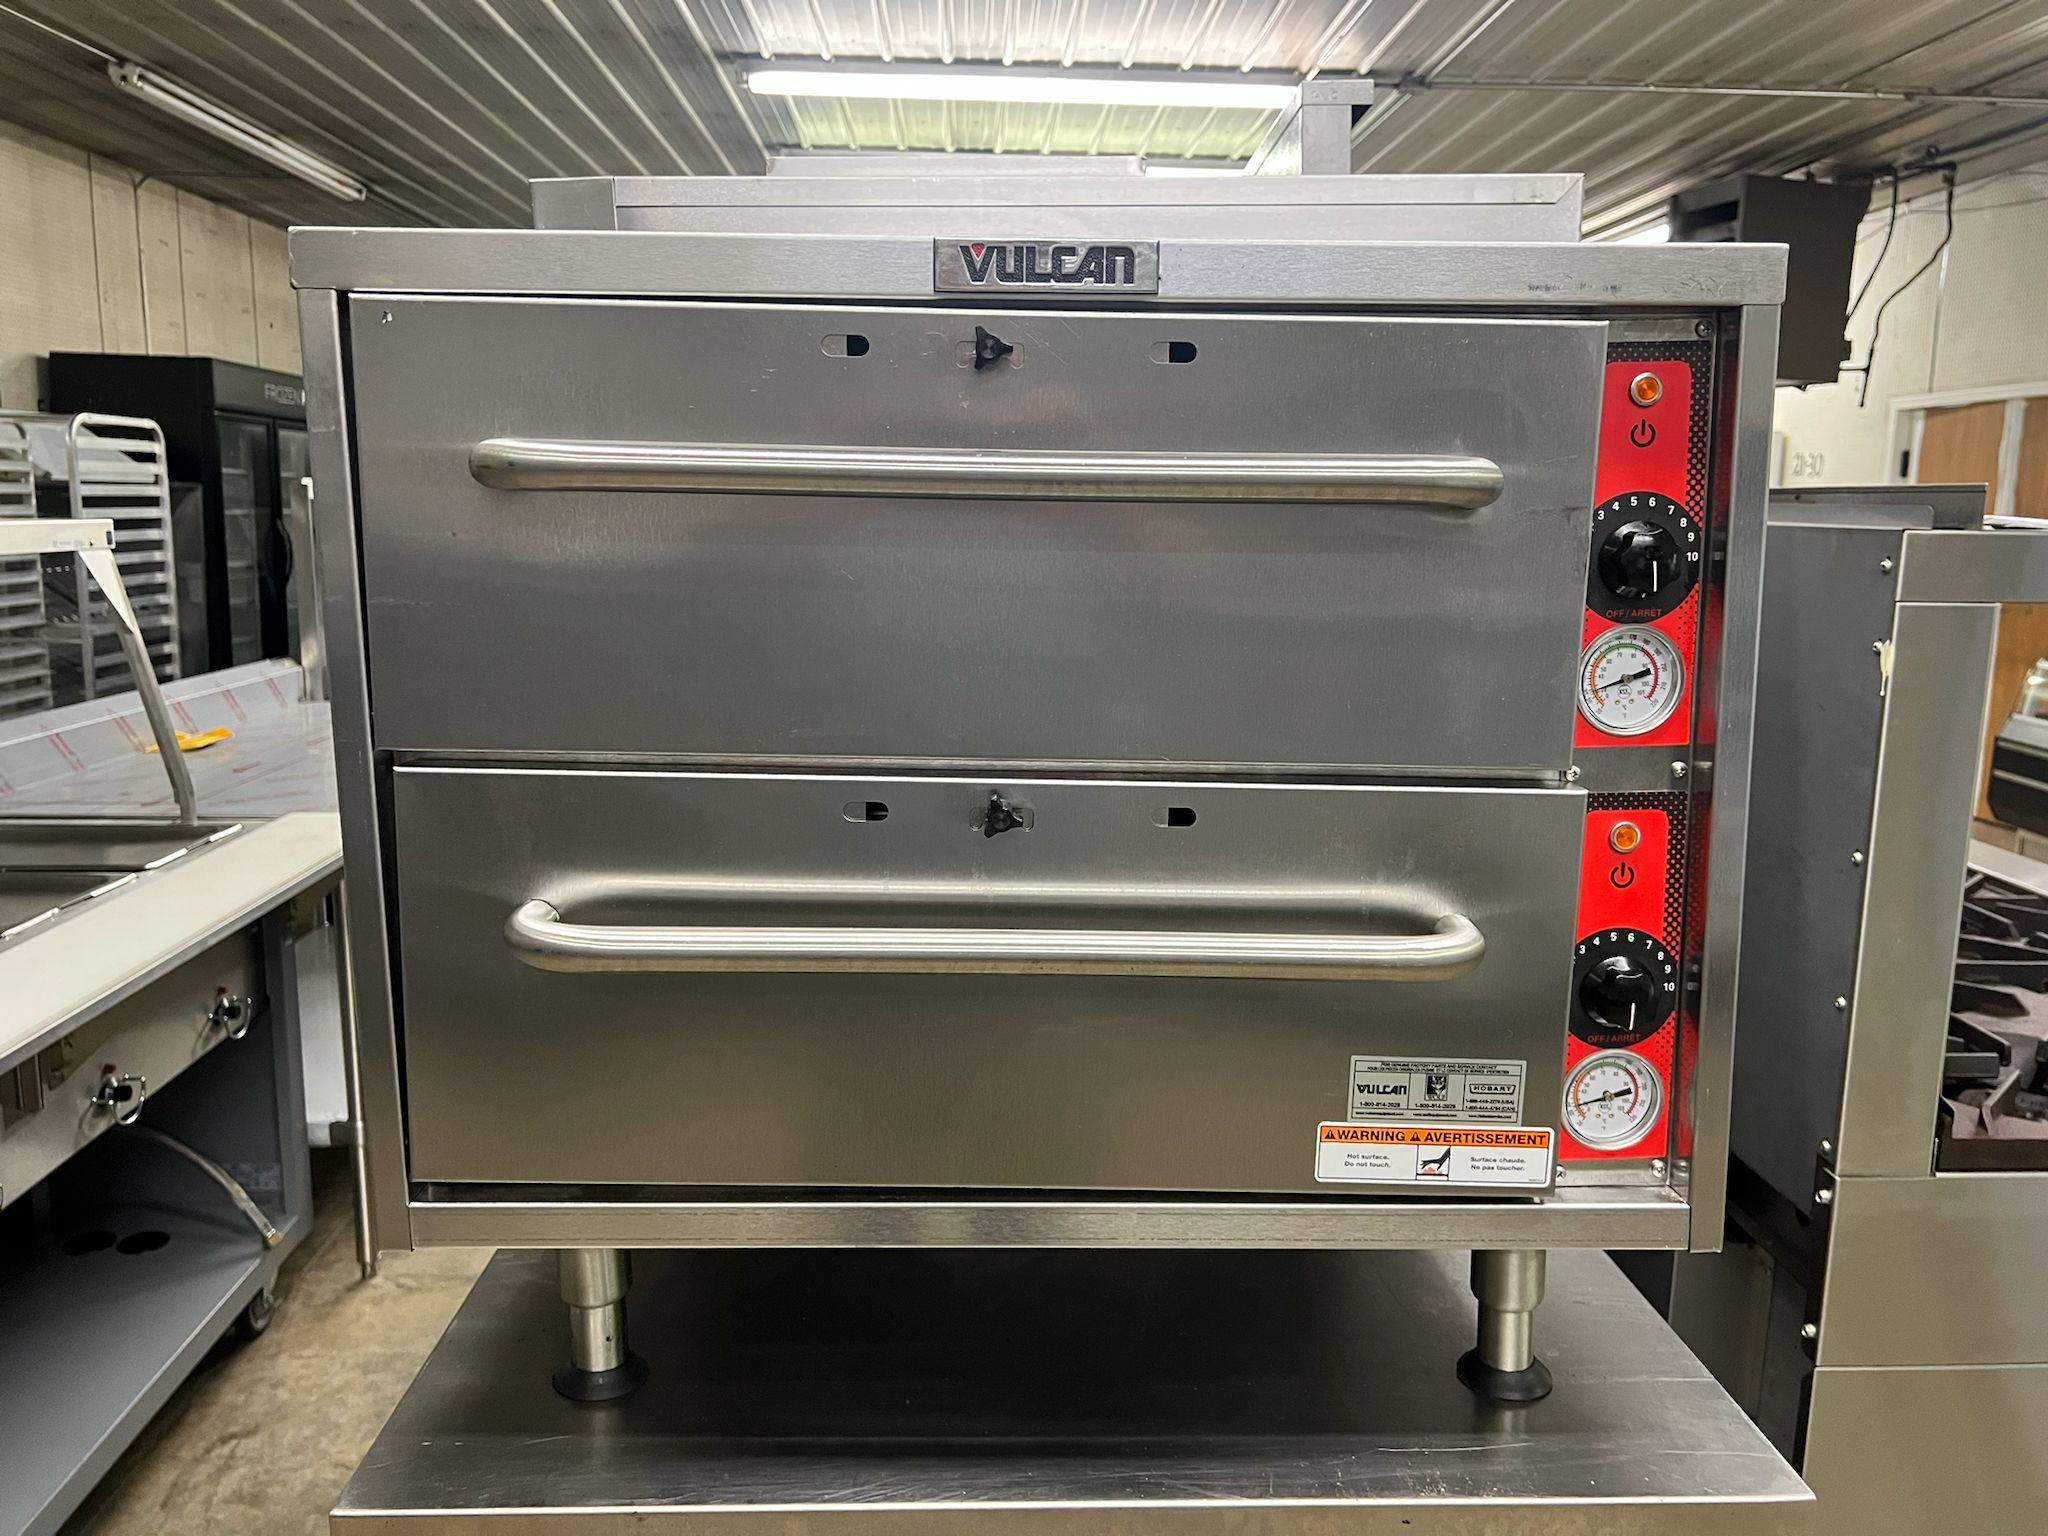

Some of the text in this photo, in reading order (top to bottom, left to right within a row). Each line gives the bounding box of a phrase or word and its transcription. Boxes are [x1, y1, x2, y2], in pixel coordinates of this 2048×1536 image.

[958, 243, 1135, 286] VULCAN
[1597, 496, 1698, 561] 3 4 5 6 7 8 9 10
[1579, 932, 1675, 991] 3 4 5 6 7 8 9 10
[1356, 1083, 1407, 1095] VULCAN
[1337, 1129, 1405, 1141] WARNING
[1424, 1132, 1546, 1145] AVERTISSEMENT
[1497, 1164, 1525, 1172] toucher.
